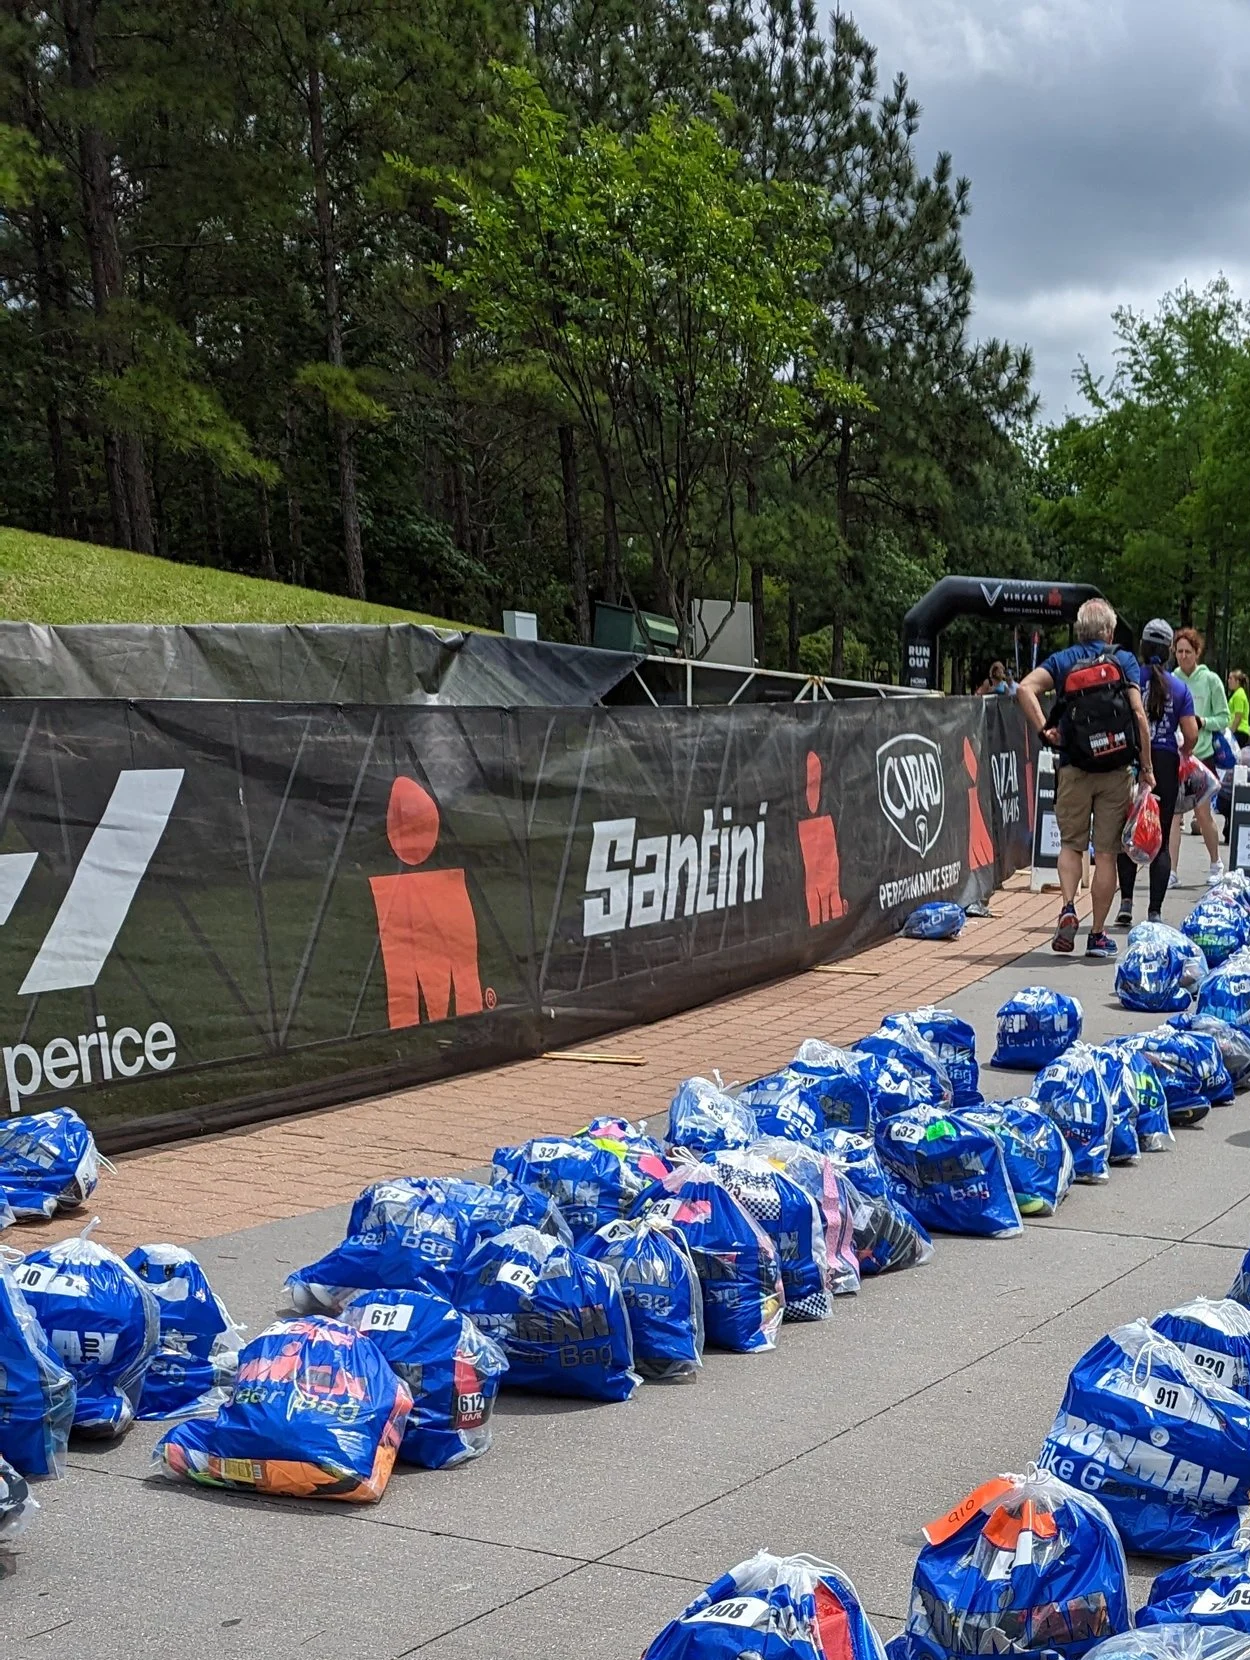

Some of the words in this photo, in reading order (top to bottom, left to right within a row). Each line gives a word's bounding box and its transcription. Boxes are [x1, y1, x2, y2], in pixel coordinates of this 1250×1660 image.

[1003, 592, 1045, 602] VINFAST
[908, 645, 931, 657] RUN
[908, 657, 930, 669] OUT
[883, 752, 942, 820] CURAD
[583, 802, 768, 937] Santini
[879, 867, 941, 910] PERFORMANCE
[775, 1106, 813, 1138] Bag
[401, 1230, 453, 1262] Bag
[510, 1268, 536, 1295] 614
[371, 1308, 399, 1327] 612
[558, 1344, 613, 1370] Bag
[1194, 1354, 1225, 1380] 920
[458, 1393, 485, 1412] 612
[1154, 1386, 1179, 1410] 917
[461, 1411, 483, 1422] KASK
[702, 1602, 747, 1620] 908
